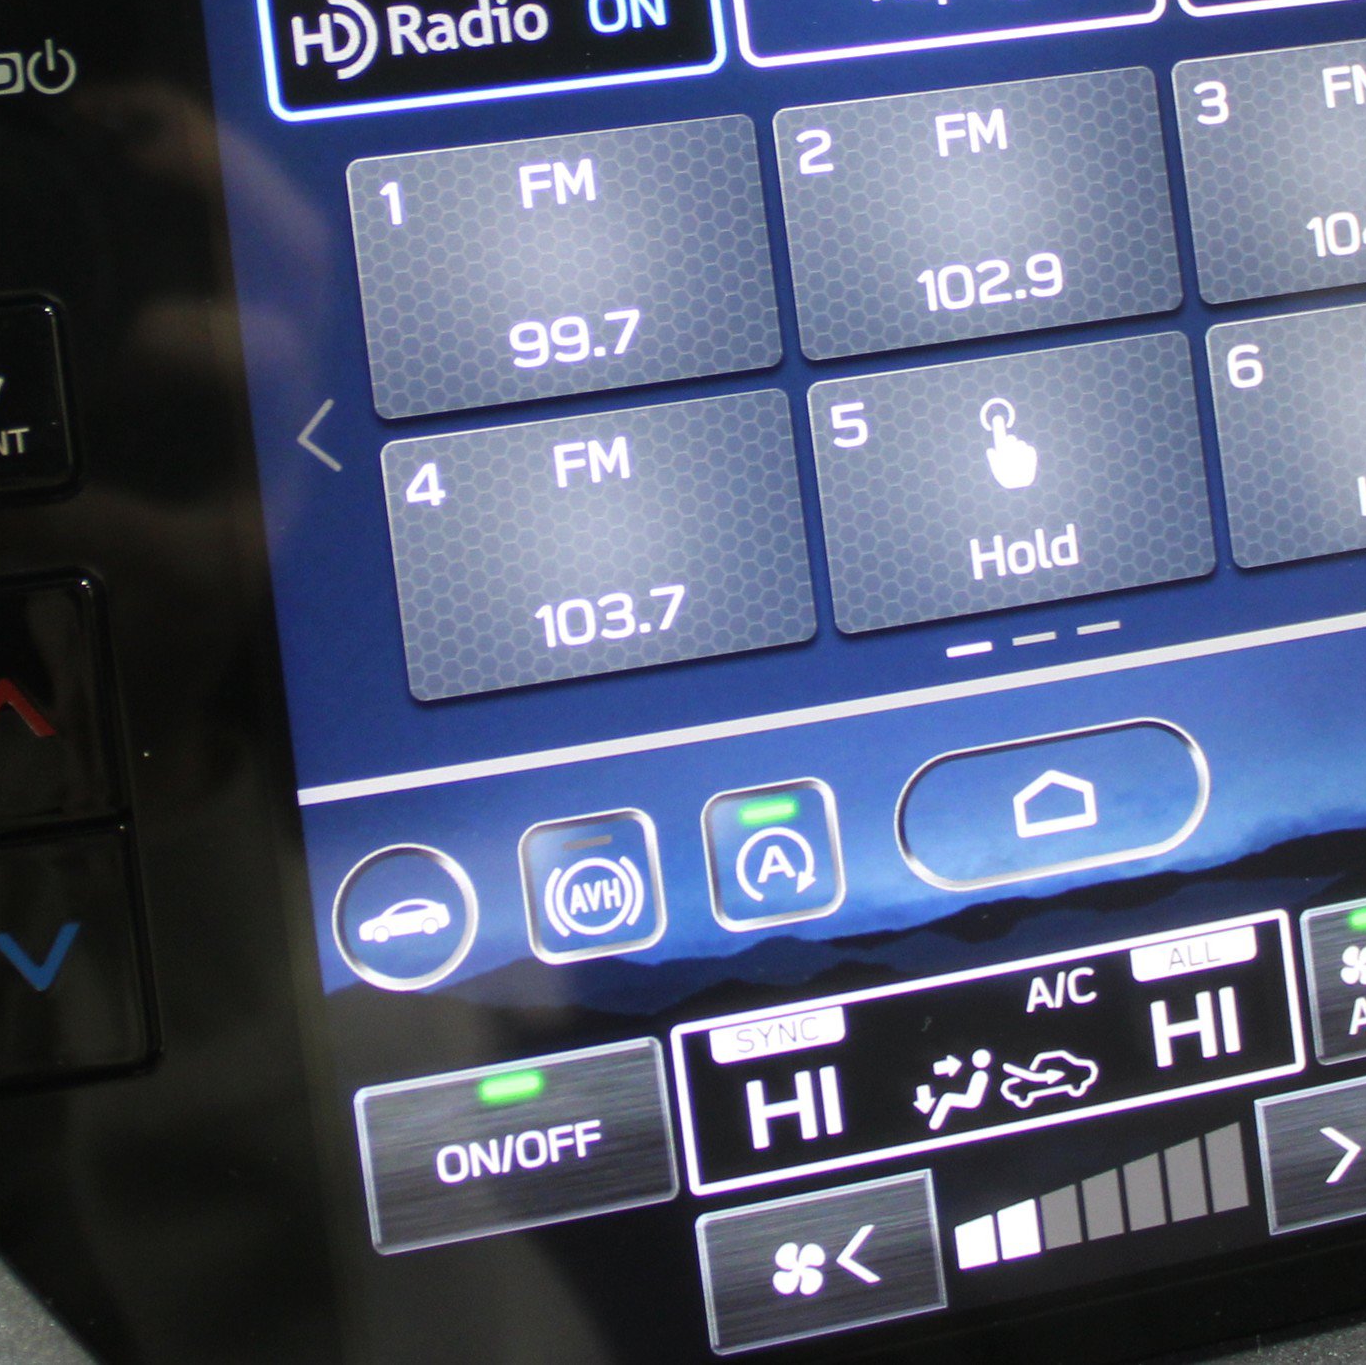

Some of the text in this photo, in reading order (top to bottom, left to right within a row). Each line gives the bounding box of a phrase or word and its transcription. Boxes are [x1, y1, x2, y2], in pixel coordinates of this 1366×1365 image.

[1192, 80, 1230, 126] 3
[795, 130, 834, 175] 2
[935, 108, 1008, 157] FM
[378, 181, 403, 226] 1
[518, 159, 597, 209] FM
[917, 252, 1064, 312] 102.9
[507, 310, 641, 370] 99.7
[1226, 344, 1264, 389] 6
[830, 402, 869, 449] 5
[405, 462, 446, 507] 4
[553, 436, 631, 488] FM
[970, 524, 1079, 580] Hold
[535, 585, 686, 649] 103.7
[569, 877, 623, 913] AVH
[1168, 941, 1220, 967] ALL
[1026, 967, 1098, 1013] A/C
[736, 1016, 821, 1054] SYNC
[1150, 986, 1241, 1069] HI
[746, 1066, 843, 1149] HI
[435, 1119, 603, 1185] ON/OFF
